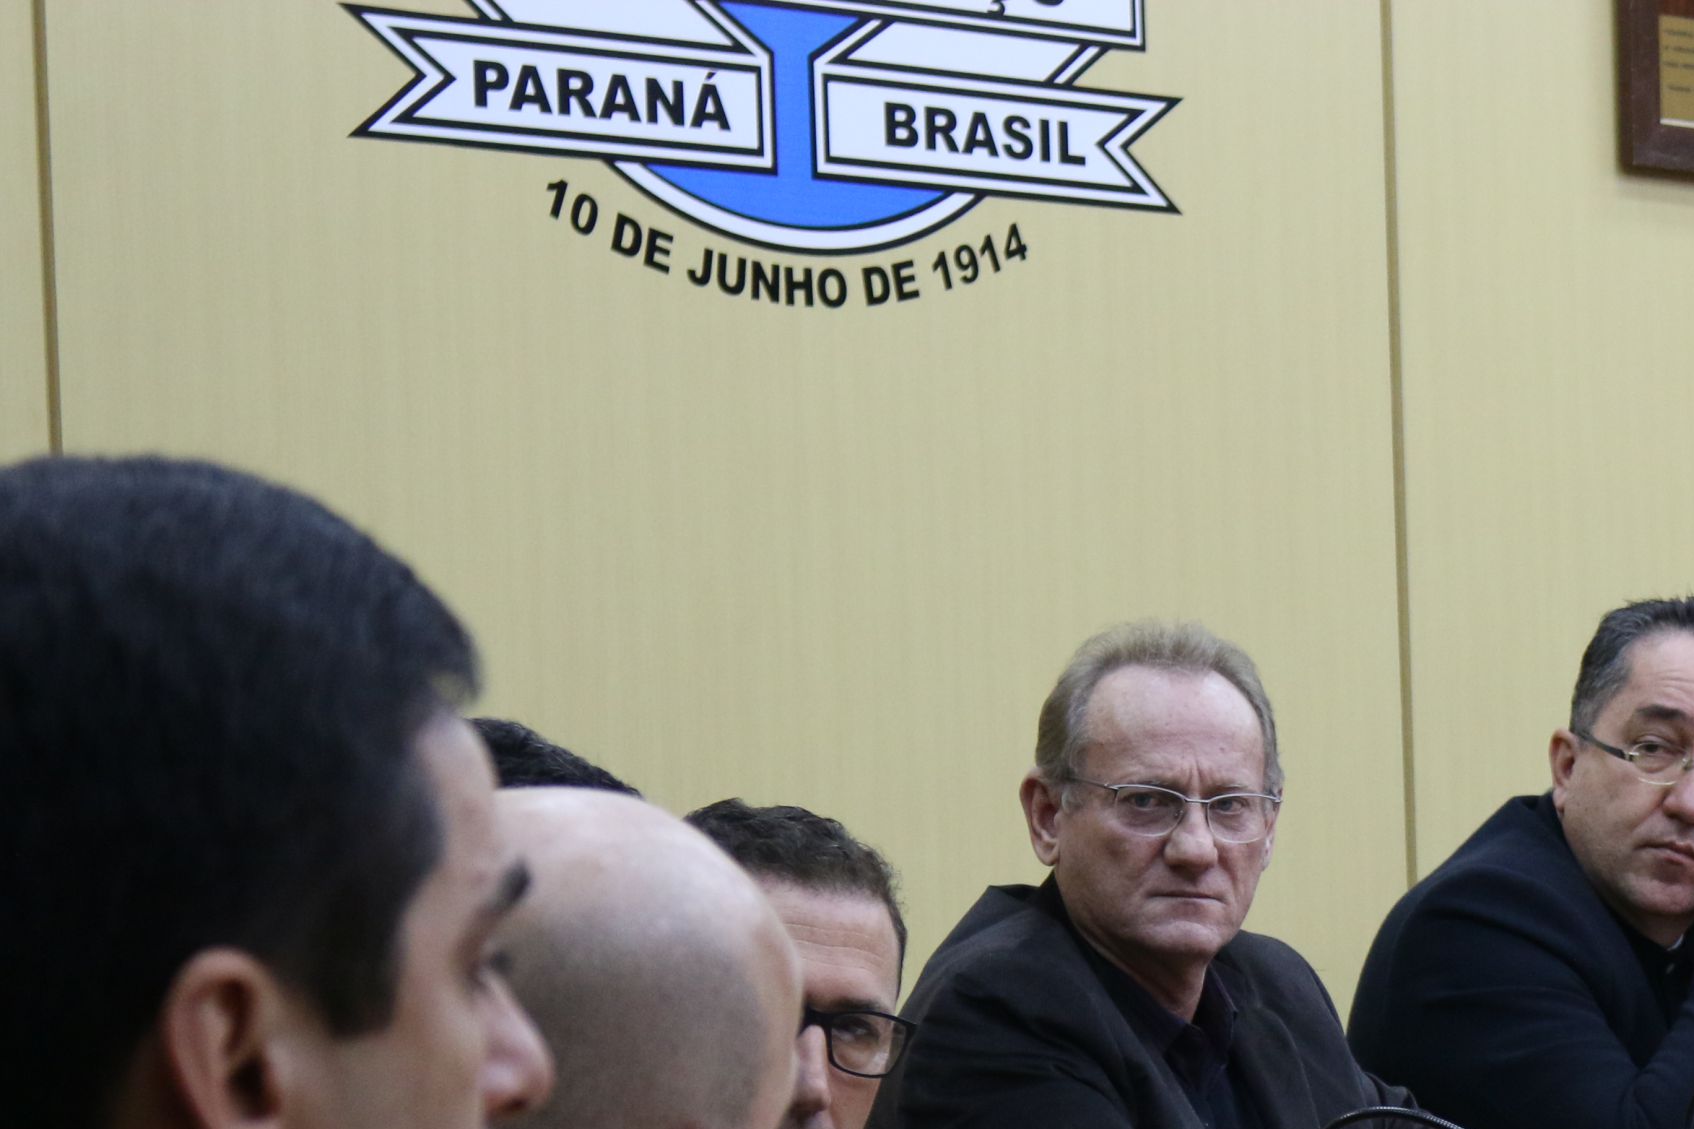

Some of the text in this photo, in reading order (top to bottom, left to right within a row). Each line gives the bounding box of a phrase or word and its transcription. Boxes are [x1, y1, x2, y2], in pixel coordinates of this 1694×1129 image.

[473, 59, 731, 131] PARANÁ
[885, 102, 1086, 166] BRASIL
[547, 179, 1028, 309] 10 DE JUNHO DE 1914
